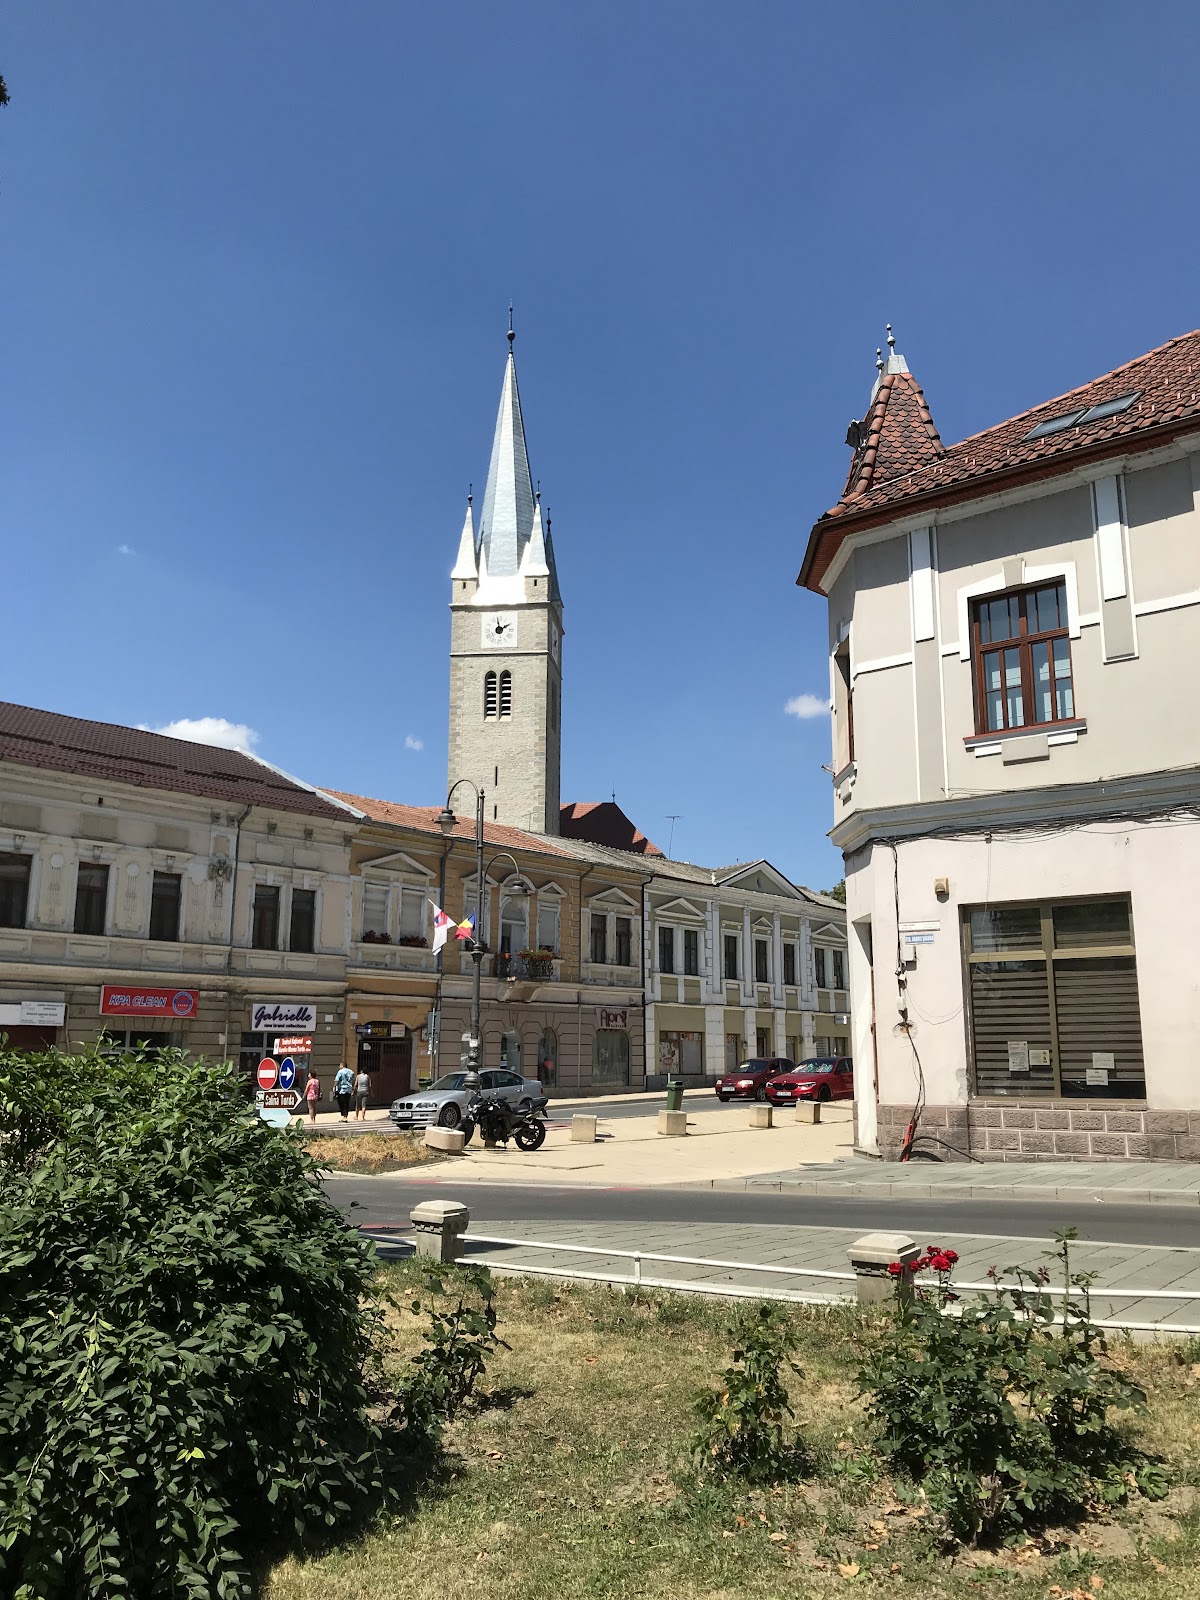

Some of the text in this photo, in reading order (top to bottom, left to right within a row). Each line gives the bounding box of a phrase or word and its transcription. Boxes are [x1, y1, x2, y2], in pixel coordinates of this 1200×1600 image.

[109, 995, 130, 1006] KPA
[132, 996, 167, 1007] CLEAN
[254, 1005, 312, 1028] Gabrielle
[601, 1009, 627, 1028] April
[265, 1094, 295, 1106] Salina Turda
